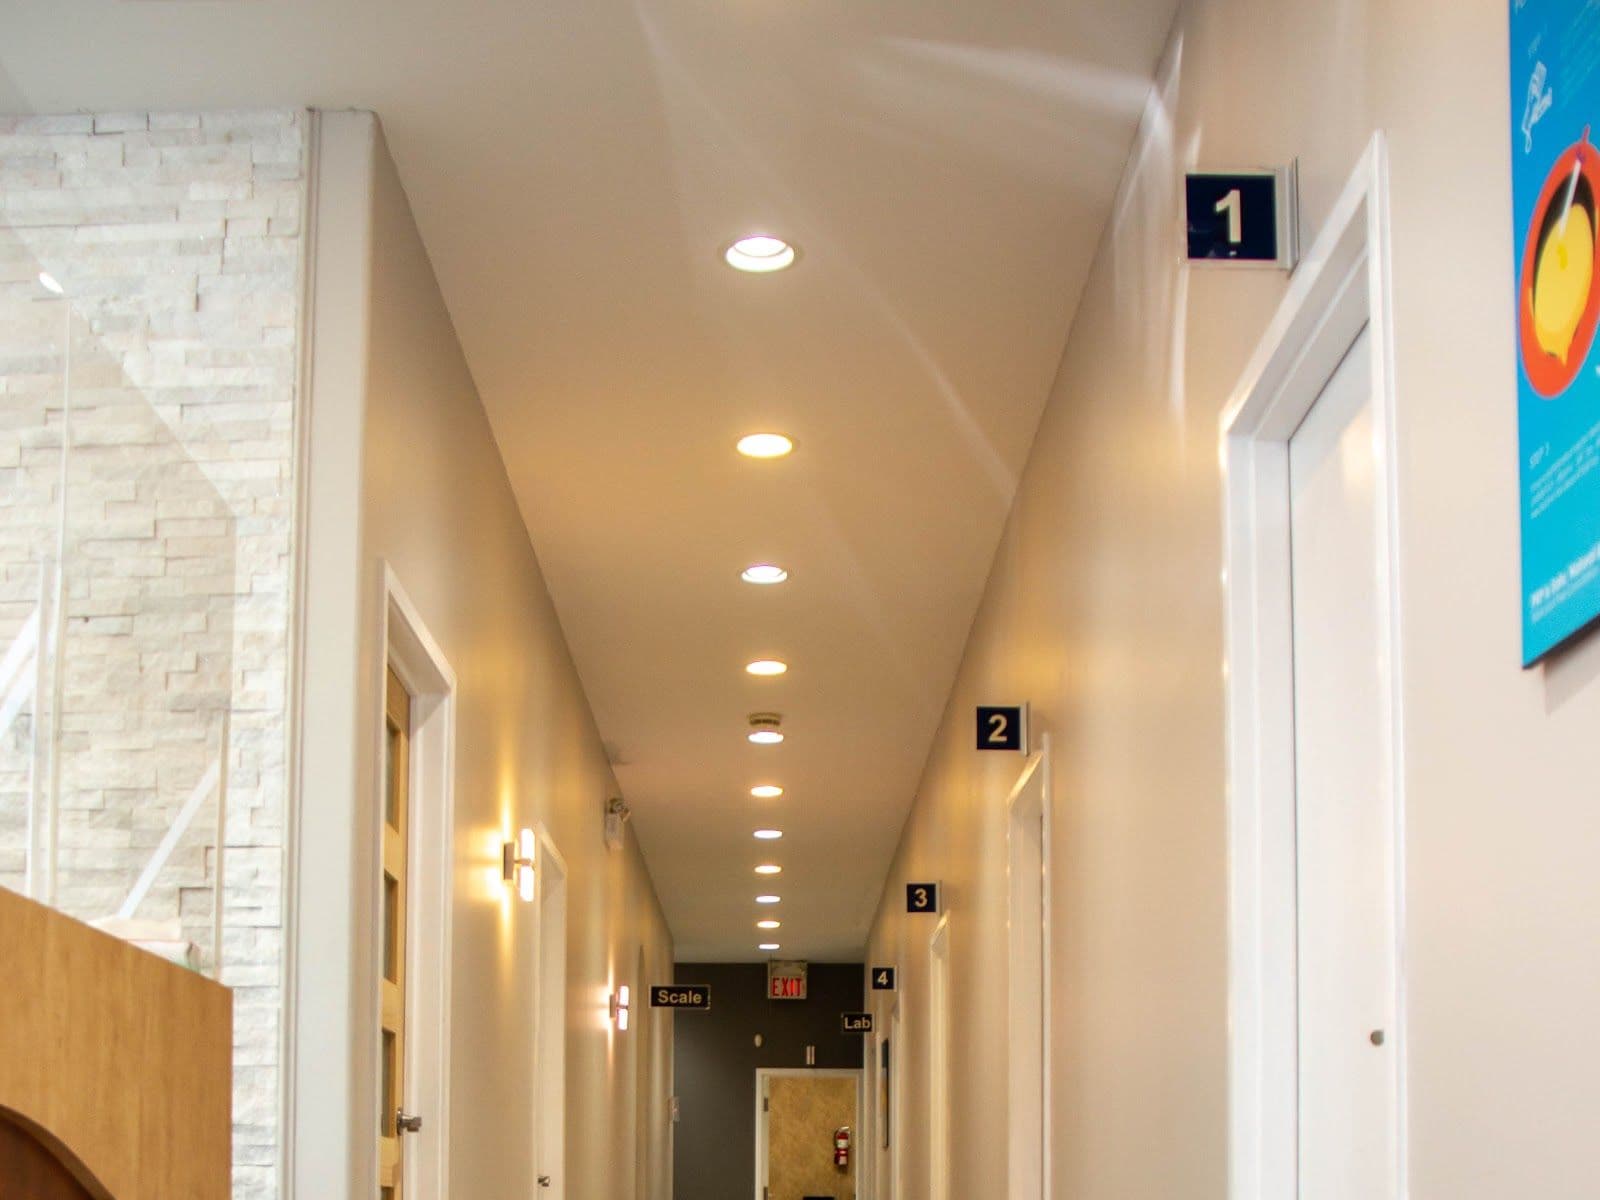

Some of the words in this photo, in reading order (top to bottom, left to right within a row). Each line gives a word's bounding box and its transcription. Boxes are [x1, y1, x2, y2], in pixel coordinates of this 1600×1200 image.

[1215, 189, 1242, 243] 1
[988, 714, 1008, 742] 2
[915, 888, 928, 907] 3
[772, 977, 802, 996] EXIT
[877, 971, 889, 985] 4
[658, 990, 702, 1004] Scale
[844, 1017, 871, 1029] Lab
